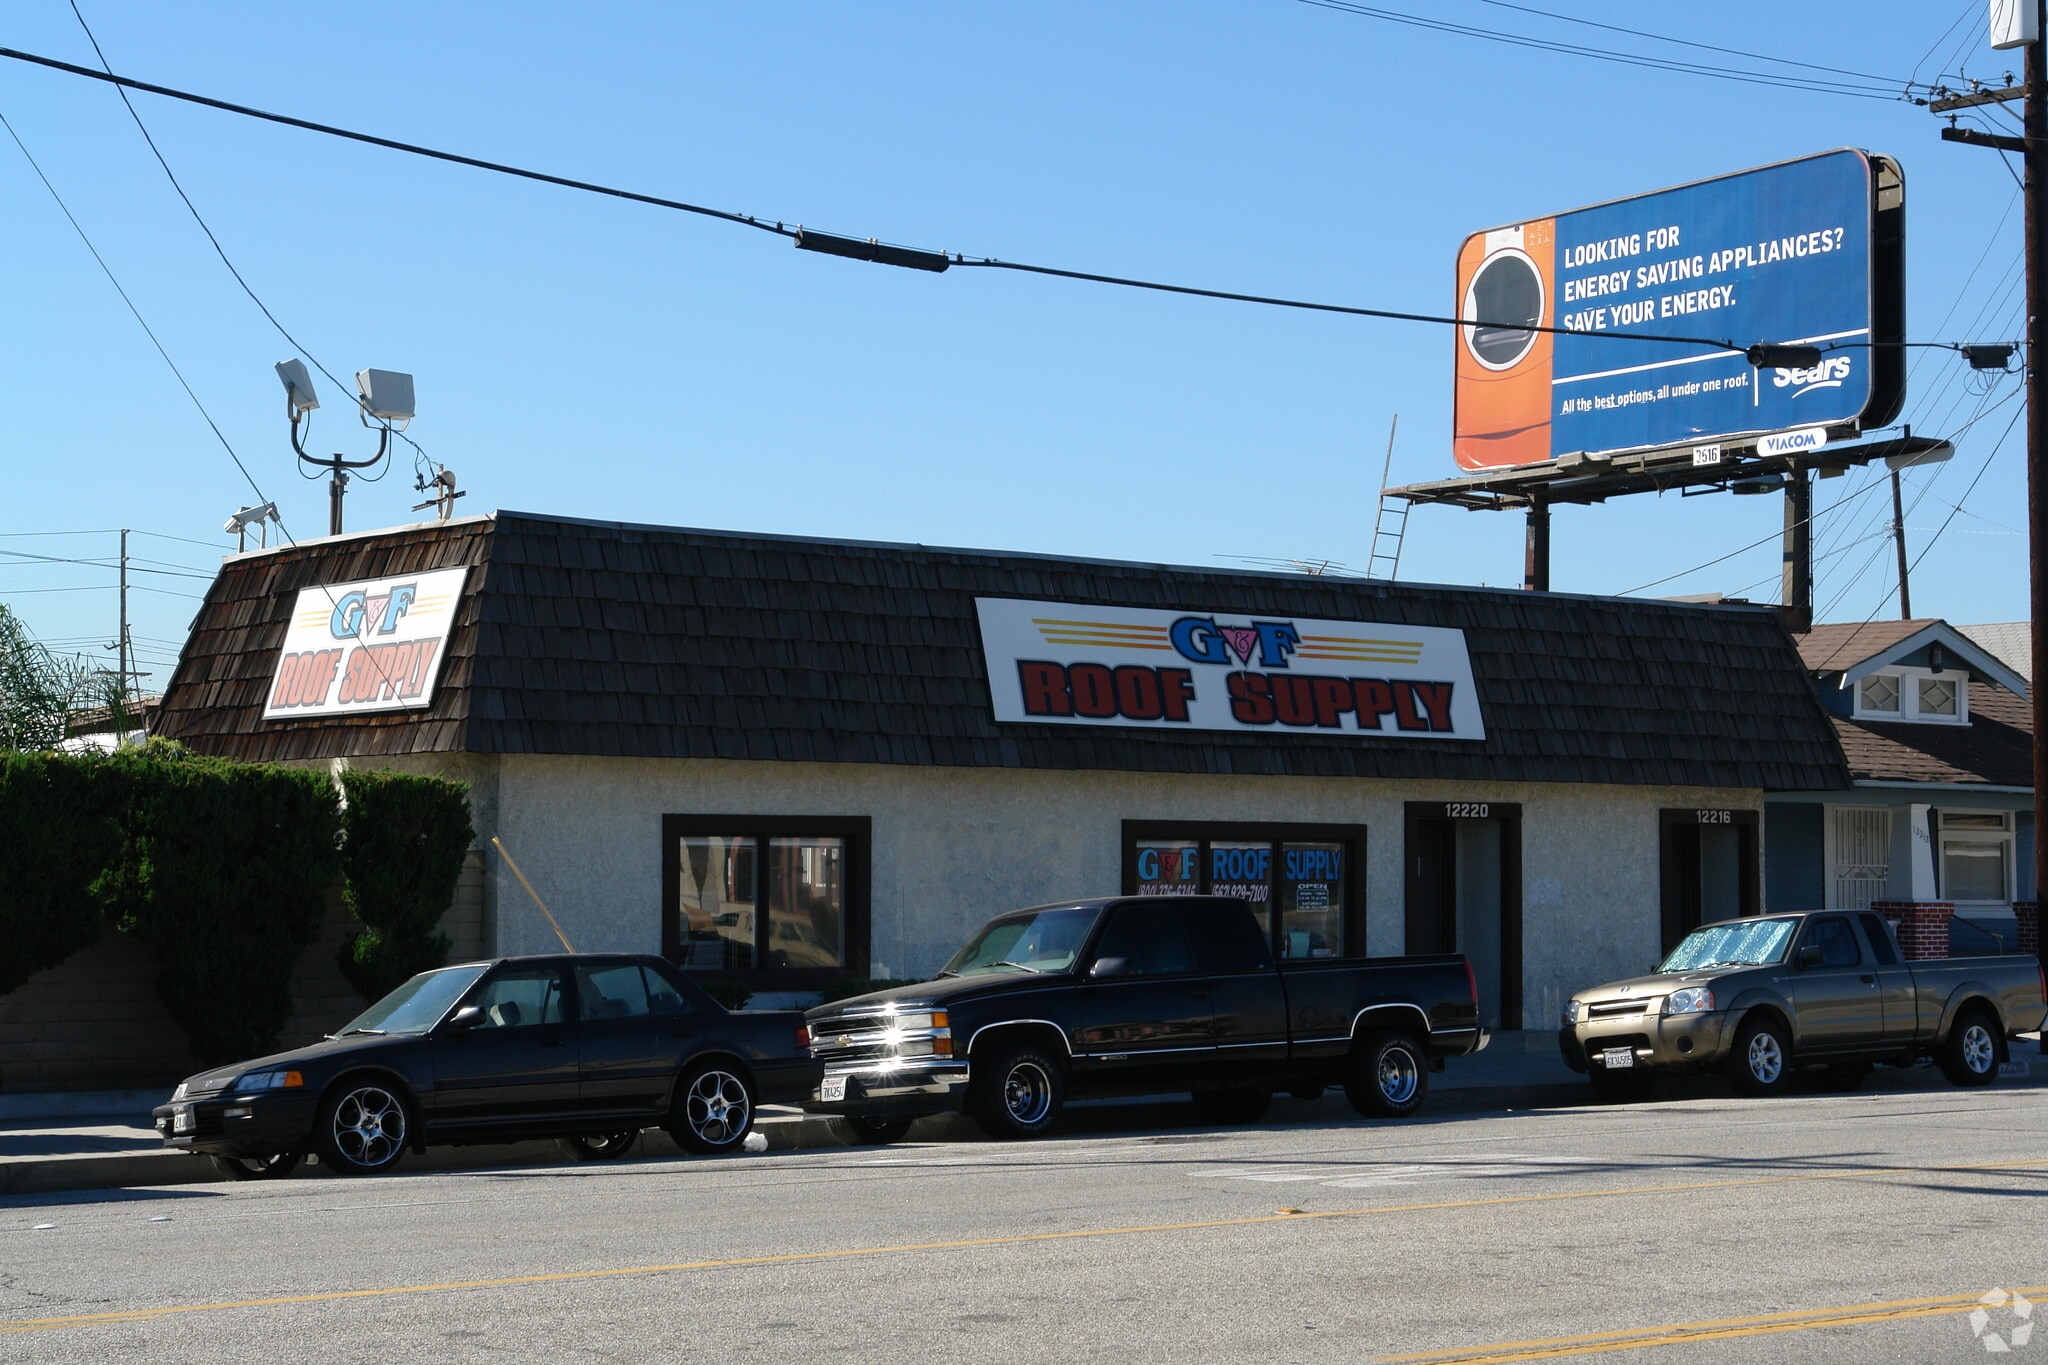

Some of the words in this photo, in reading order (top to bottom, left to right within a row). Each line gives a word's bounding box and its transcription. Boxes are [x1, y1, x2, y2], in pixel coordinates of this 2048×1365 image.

[1565, 234, 1640, 269] LOOKING
[1647, 225, 1680, 252] FOR
[1565, 270, 1631, 302] ENERGY
[1637, 255, 1703, 289] SAVING
[1708, 227, 1844, 274] APPLIANCES?
[1564, 308, 1607, 333] SAVE
[1610, 300, 1655, 327] YOUR
[1661, 285, 1736, 318] ENERGY.
[1773, 356, 1851, 388] Sears
[1562, 399, 1574, 414] All
[1577, 397, 1592, 411] the
[1595, 393, 1615, 409] best
[1617, 388, 1656, 407] options,
[1657, 384, 1669, 399] all
[1672, 381, 1700, 397] under
[1702, 379, 1721, 392] one
[1724, 372, 1749, 389] roof.
[1695, 447, 1718, 463] 3516
[1767, 434, 1816, 450] VIACOM
[270, 648, 344, 710] ROOF
[338, 637, 442, 704] SUPPLY
[1016, 659, 1197, 723] ROOF
[1226, 670, 1455, 733] SUPPLY
[1445, 803, 1489, 817] 12220
[1696, 810, 1731, 824] 12216
[1212, 848, 1271, 881] ROOF
[1285, 850, 1341, 881] SUPPLY
[1231, 884, 1269, 902] 929-7100
